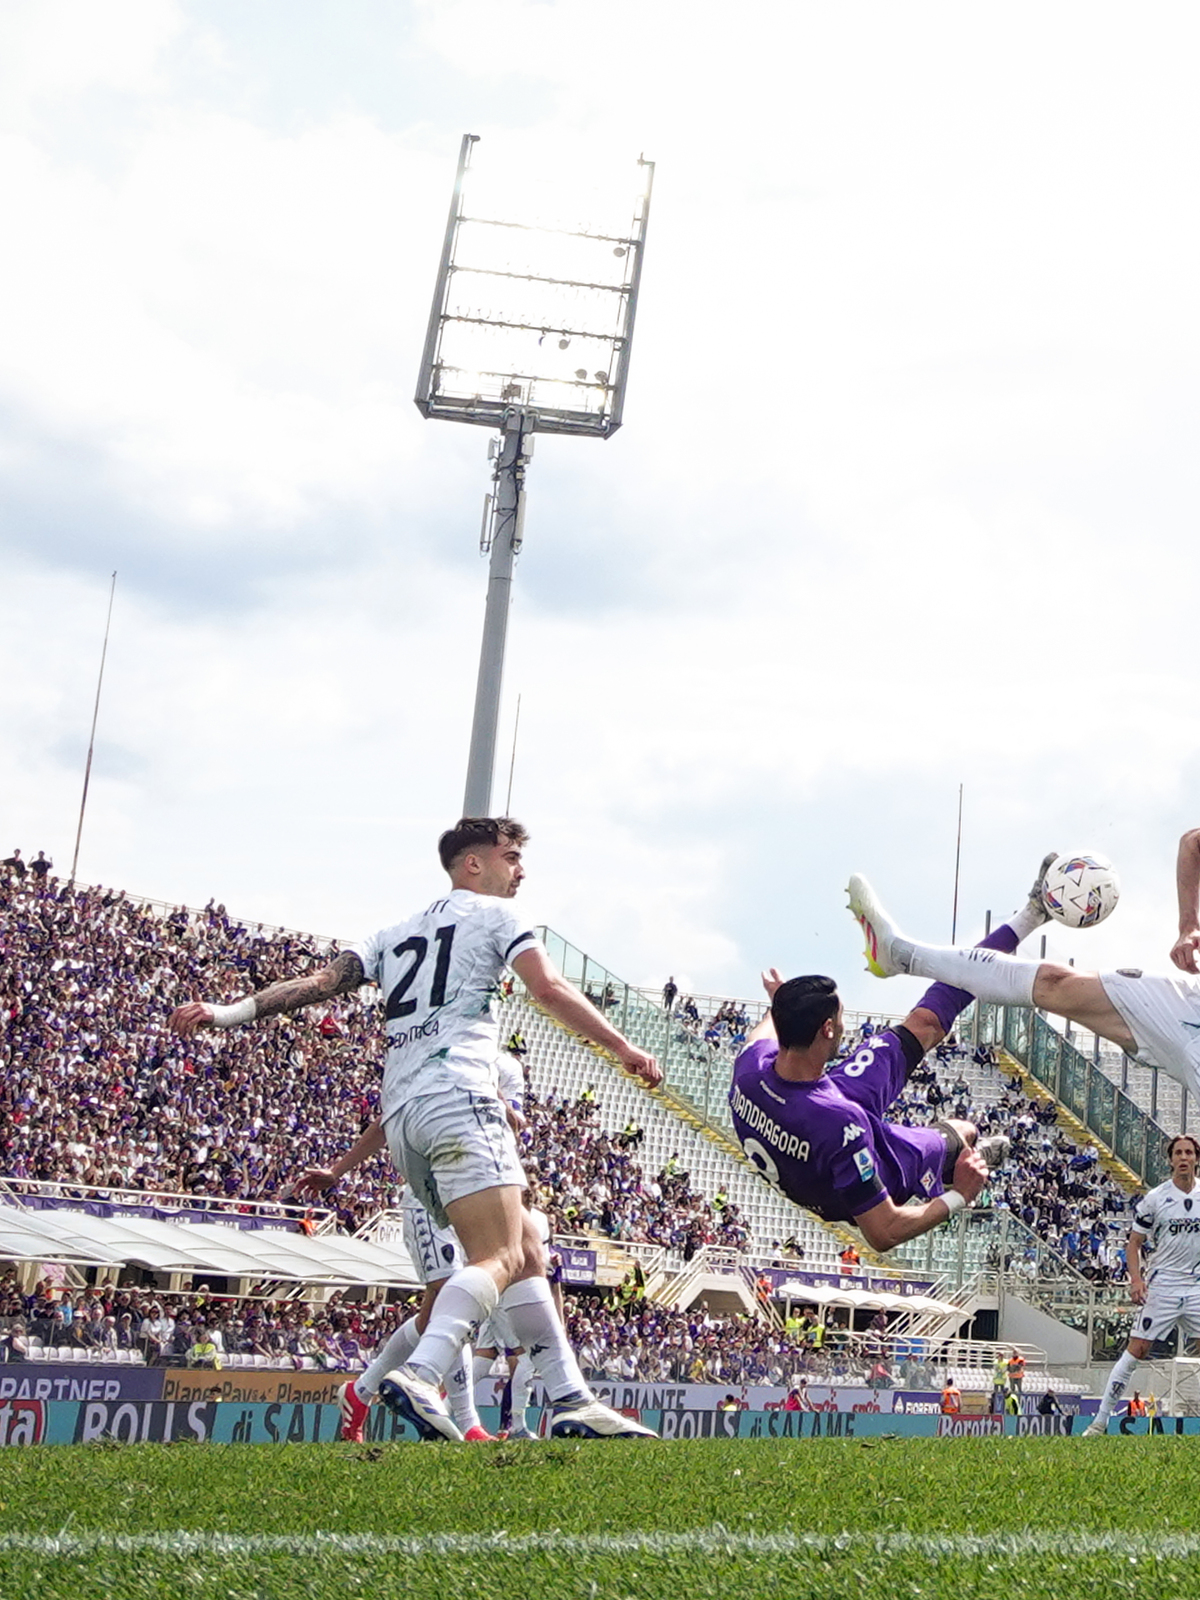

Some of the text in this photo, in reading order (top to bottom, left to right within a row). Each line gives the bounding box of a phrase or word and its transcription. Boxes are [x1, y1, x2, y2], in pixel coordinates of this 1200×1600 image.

[386, 924, 456, 1020] 21
[844, 1048, 874, 1077] 8
[731, 1085, 810, 1162] MANDRAGORA
[1, 1378, 121, 1400] PARTNER
[232, 1410, 253, 1443] di
[264, 1403, 405, 1443] SALME
